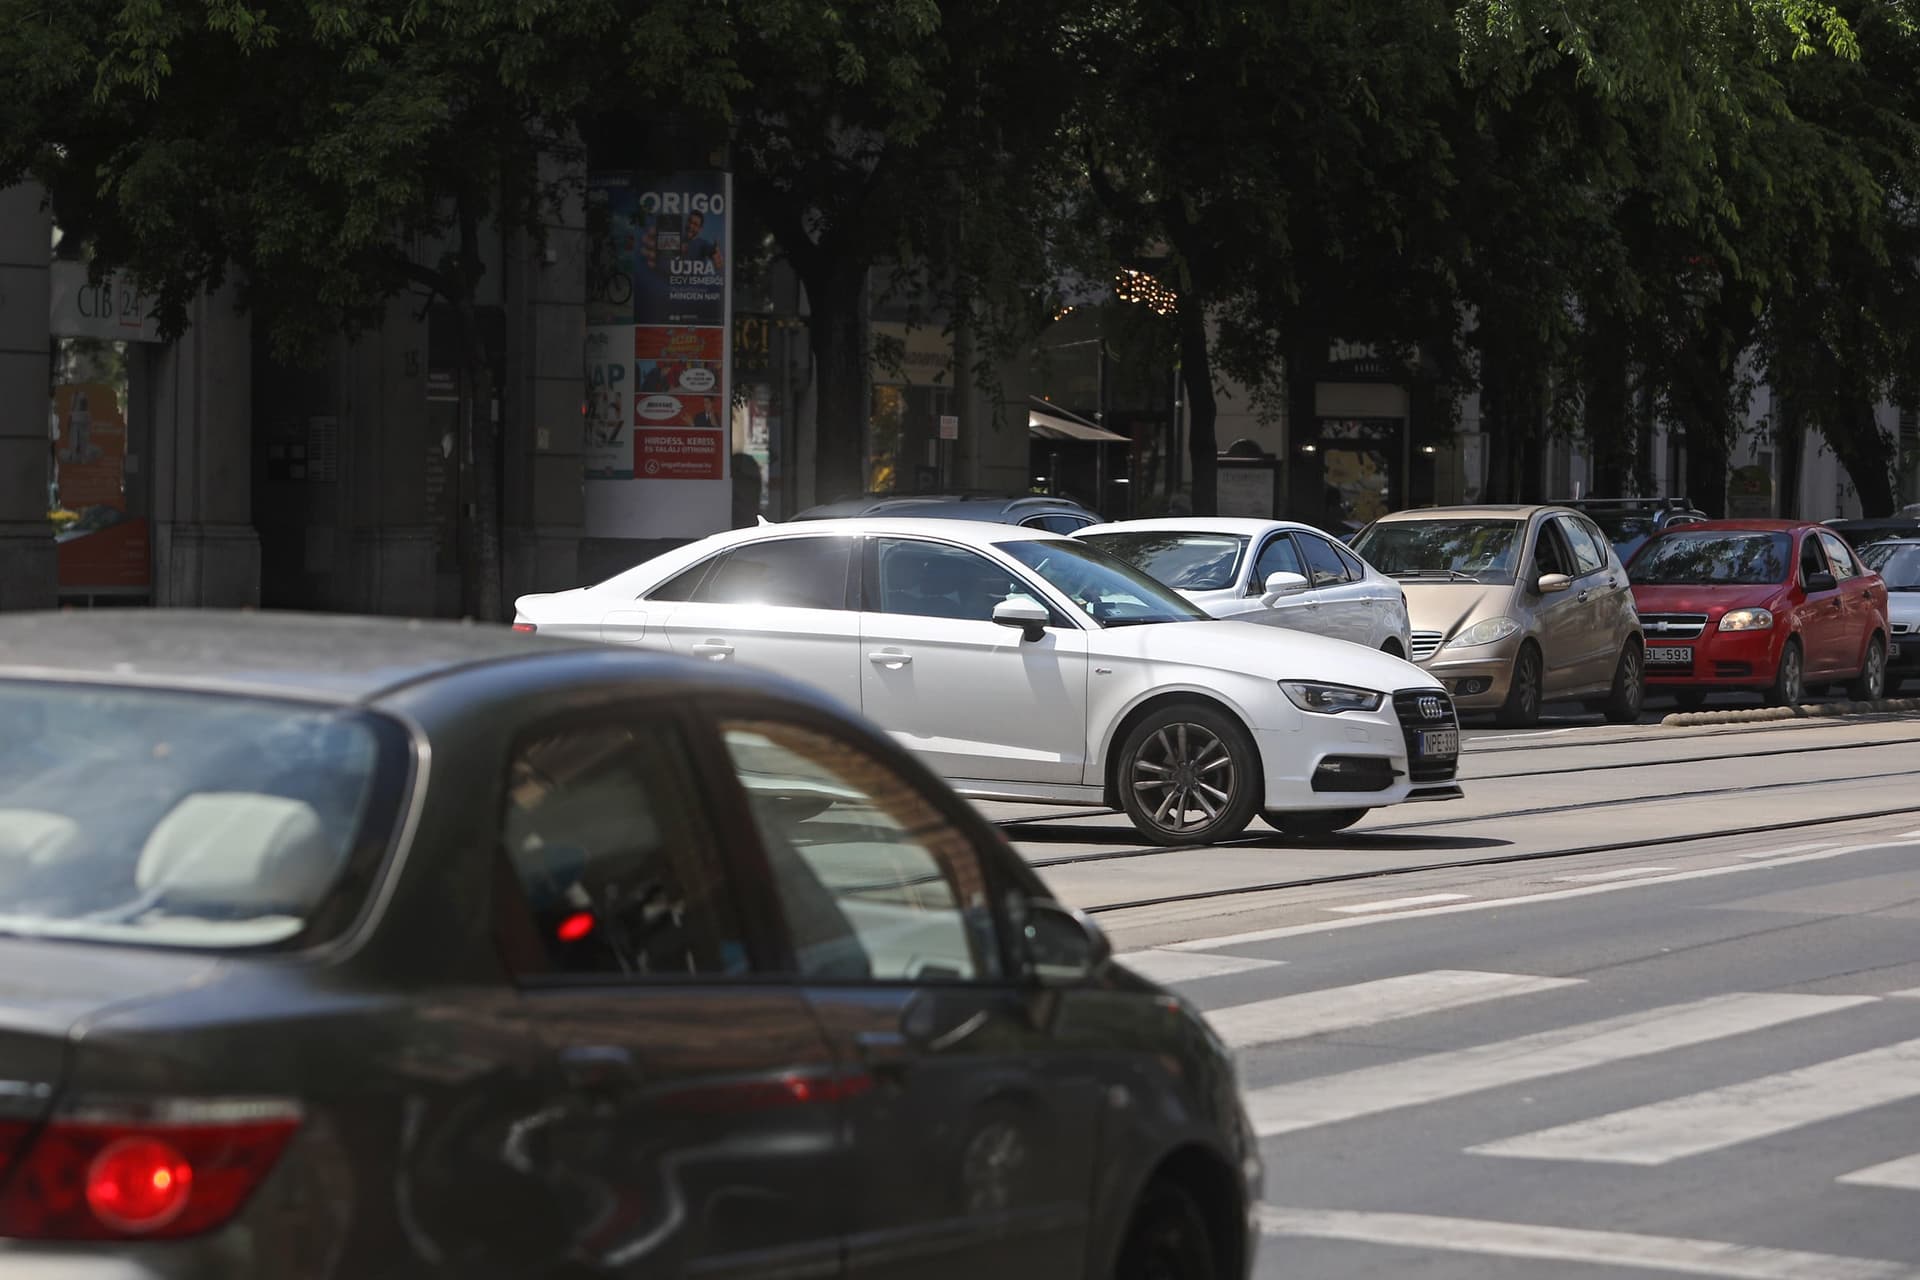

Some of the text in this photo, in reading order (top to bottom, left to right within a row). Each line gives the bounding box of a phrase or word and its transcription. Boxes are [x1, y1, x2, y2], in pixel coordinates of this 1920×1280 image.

[640, 191, 724, 215] ORIGO
[670, 255, 716, 275] ÚJRA
[77, 283, 139, 318] CIB 24
